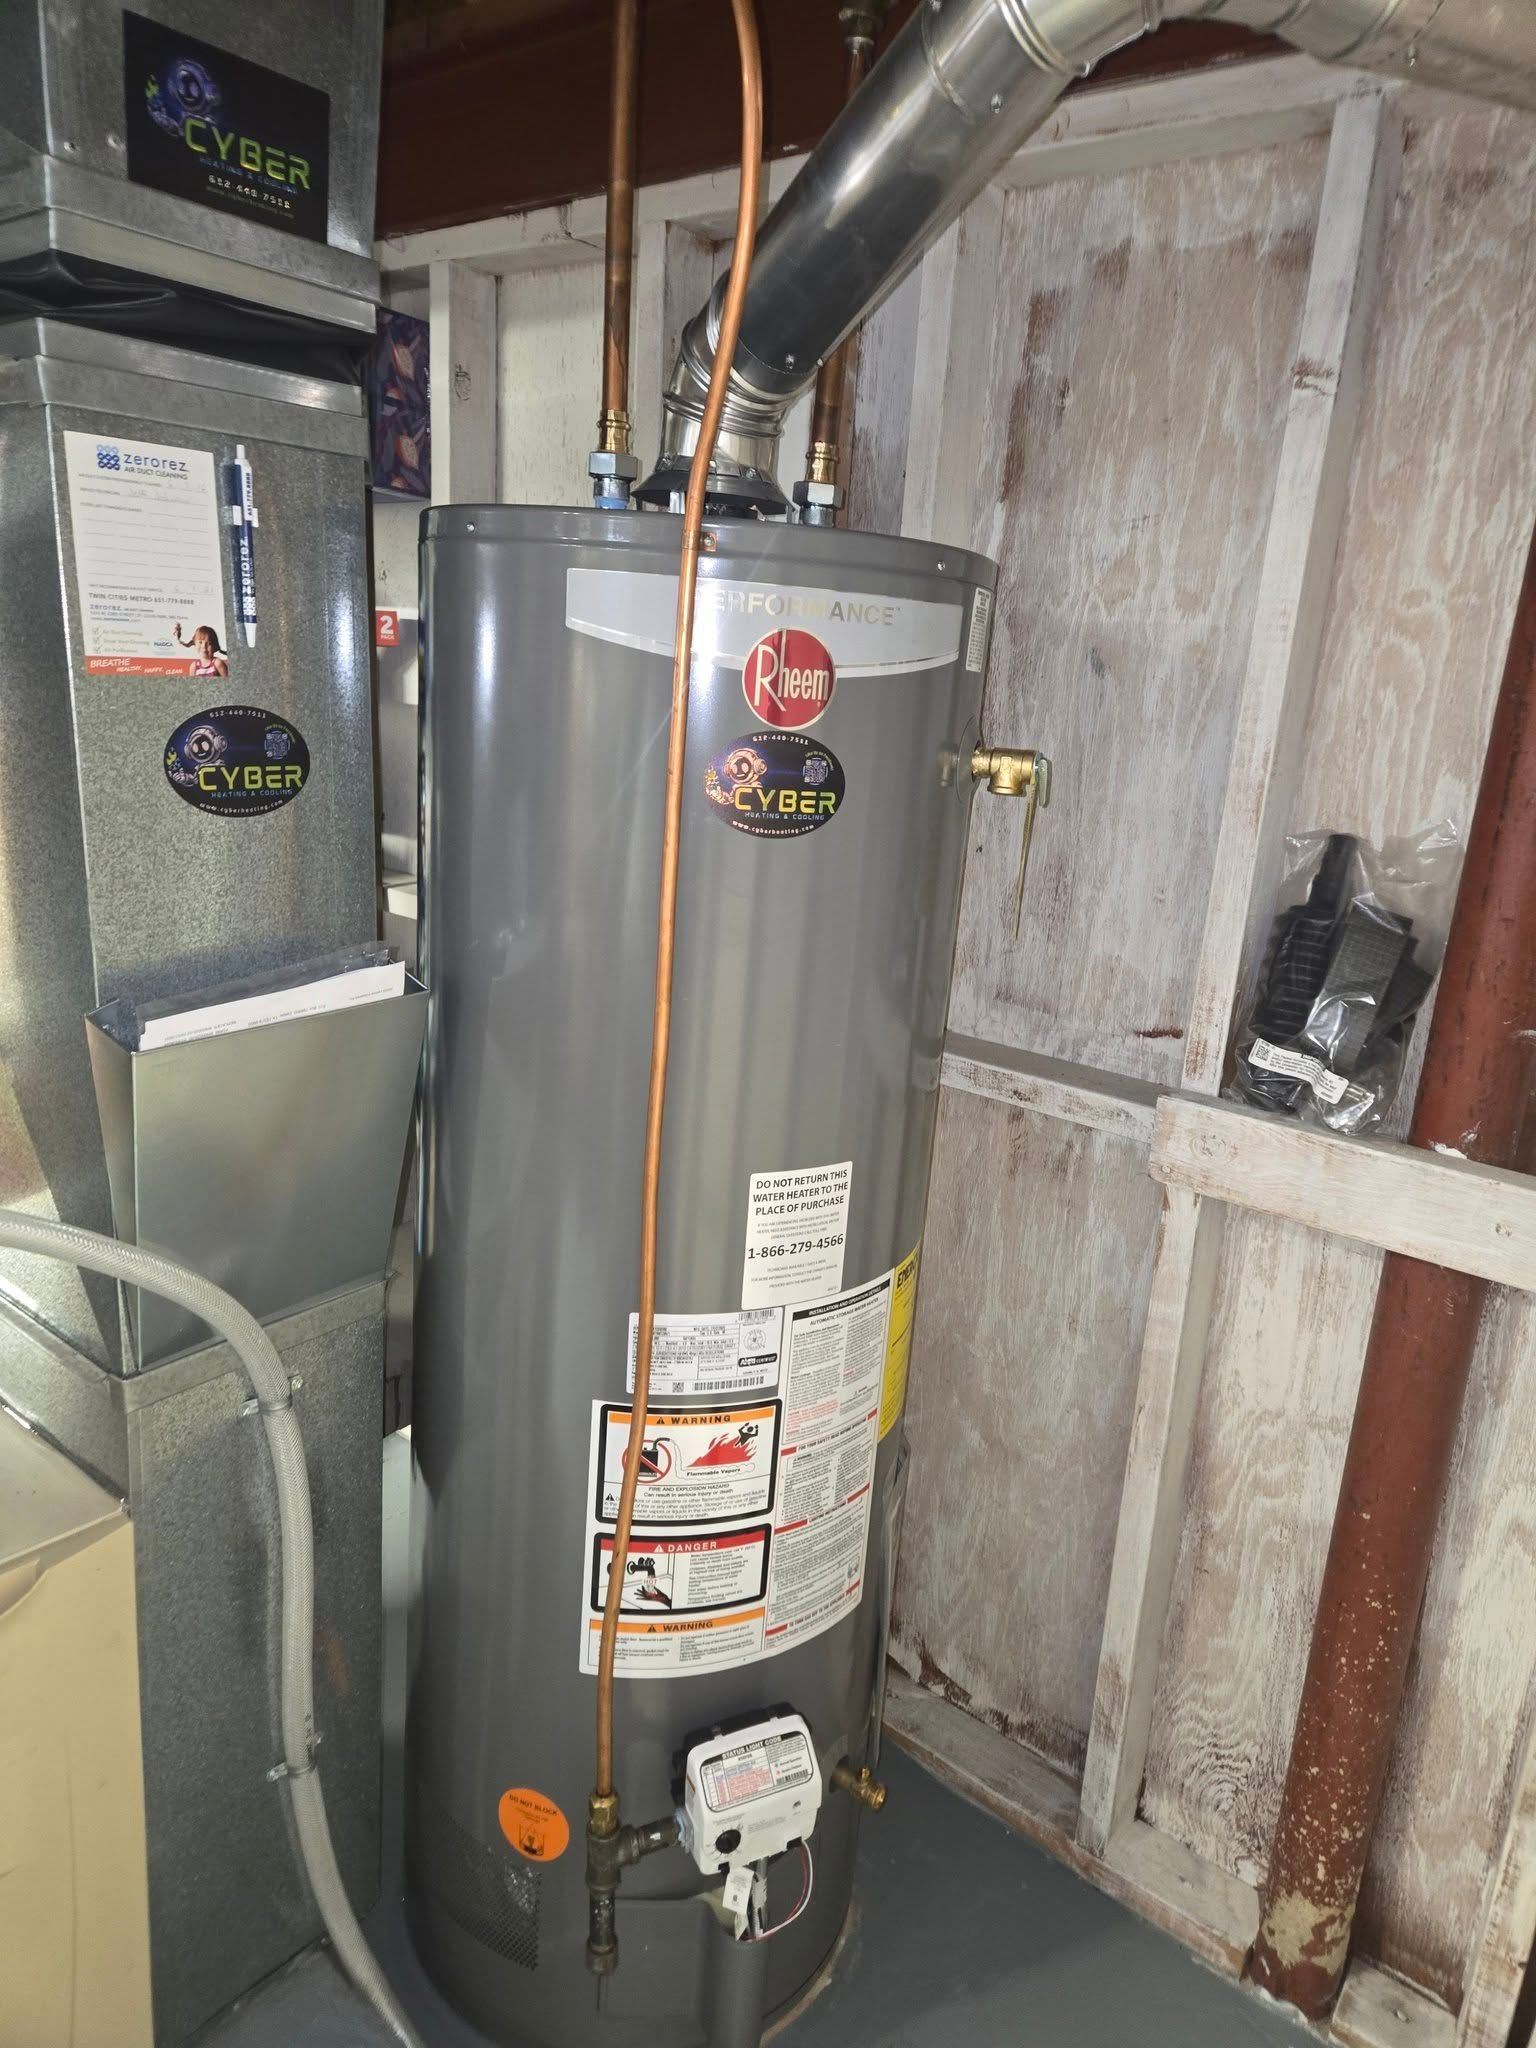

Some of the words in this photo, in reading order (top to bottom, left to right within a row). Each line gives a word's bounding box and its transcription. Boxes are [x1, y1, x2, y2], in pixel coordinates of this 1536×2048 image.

[185, 117, 311, 190] CYBER
[123, 454, 190, 472] zerorez
[124, 466, 136, 474] AIR
[137, 468, 154, 477] DUCT
[155, 470, 188, 481] CLEANING
[130, 594, 152, 603] METRO
[380, 615, 394, 635] 2
[90, 658, 130, 669] BREATHE
[753, 629, 830, 713] Rheem
[199, 765, 302, 791] CYBER
[260, 789, 293, 797] COOLING
[734, 787, 836, 814] CYBER
[745, 811, 780, 820] HEATING
[792, 813, 825, 821] COOLING
[756, 1180, 771, 1190] DO
[773, 1178, 794, 1188] NOT
[794, 1173, 829, 1186] RETURN
[830, 1169, 848, 1180] THIS
[753, 1191, 785, 1203] WATER
[786, 1187, 820, 1200] HEATER
[821, 1185, 833, 1195] TO
[833, 1181, 849, 1192] THE
[755, 1205, 785, 1216] PLACE
[787, 1204, 800, 1213] OF
[800, 1195, 844, 1211] PURCHASE
[748, 1233, 844, 1259] 1-866-279-4566
[671, 1414, 731, 1425] WARNING
[668, 1541, 717, 1552] DANGER
[663, 1621, 713, 1632] WARNING
[722, 1747, 746, 1760] STATUS
[746, 1741, 764, 1752] LIGHT
[764, 1736, 782, 1746] CODE
[509, 1794, 519, 1803] DO
[520, 1799, 533, 1808] NOT
[534, 1804, 558, 1816] BLOCK
